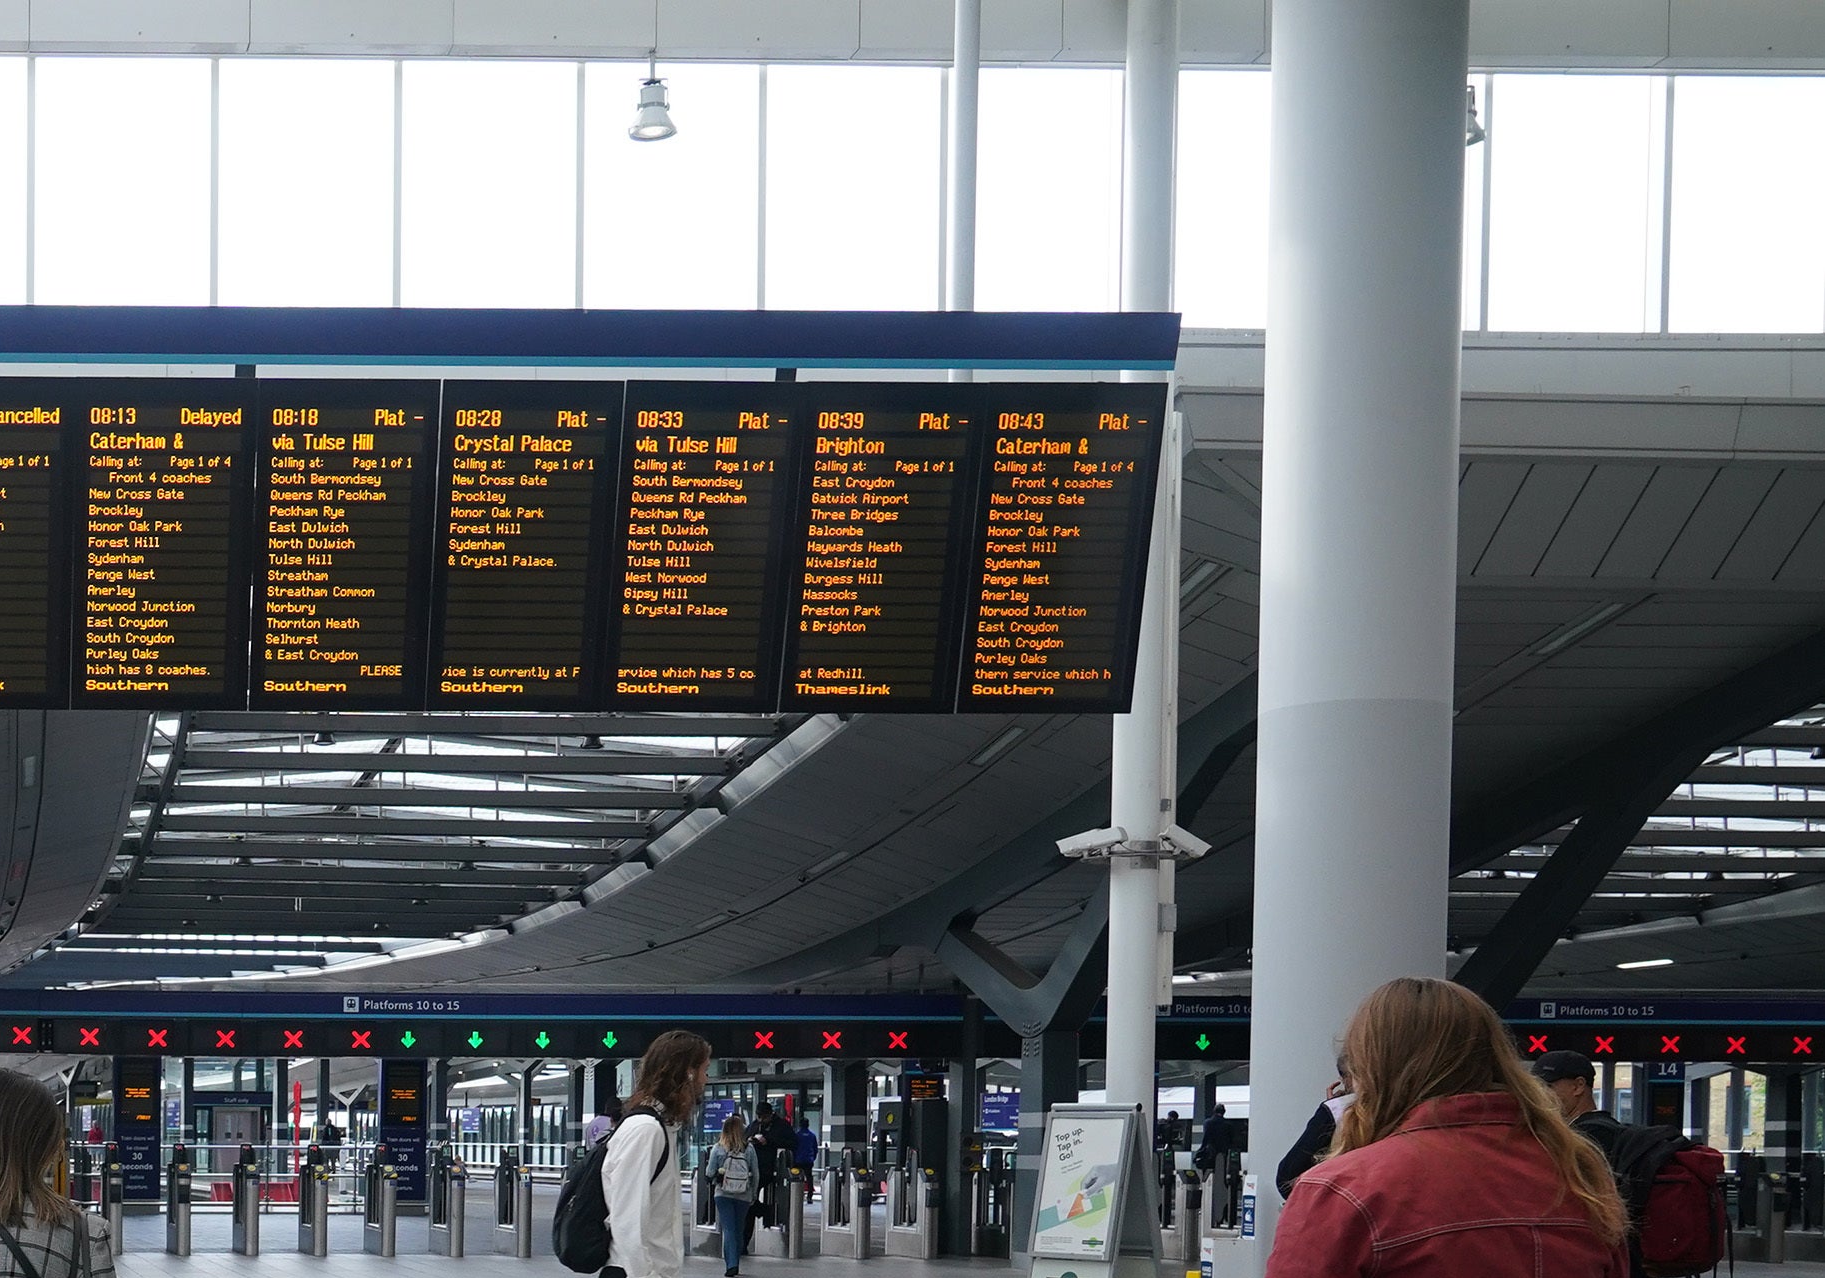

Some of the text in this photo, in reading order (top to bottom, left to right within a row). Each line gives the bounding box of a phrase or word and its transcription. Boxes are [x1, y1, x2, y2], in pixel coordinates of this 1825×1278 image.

[90, 407, 242, 428] 08:13 Delayed
[272, 408, 406, 427] 08:18 Plat
[455, 409, 589, 428] 08:28 Plat
[637, 410, 770, 430] 08:33 Plat
[817, 411, 951, 431] 08:39 Plat
[998, 412, 1130, 431] 08:43 Plat
[89, 432, 184, 450] Caterham &
[272, 433, 374, 451] via Tulse Hill
[454, 434, 573, 454] Crystal Palace
[635, 435, 738, 455] via Tulse Hill
[815, 436, 885, 457] Brighton
[995, 437, 1089, 455] Caterham &
[85, 679, 169, 691] Southern
[263, 680, 347, 692] Southern
[440, 681, 524, 693] Southern
[616, 681, 700, 694] Southern
[795, 683, 891, 695] Thameslink
[971, 683, 1054, 695] Southern
[363, 999, 460, 1011] Platforms 10 to 15
[1175, 1003, 1225, 1014] Platforms
[1228, 1003, 1241, 1014] 10
[1560, 1005, 1655, 1016] Platforms 10 to 15
[1658, 1062, 1678, 1076] 14
[1055, 1132, 1070, 1142] Top
[1057, 1142, 1072, 1152] Tap
[131, 1152, 143, 1161] 30
[397, 1153, 409, 1162] 30
[1059, 1149, 1074, 1161] Go!
[121, 1162, 154, 1171] seconds
